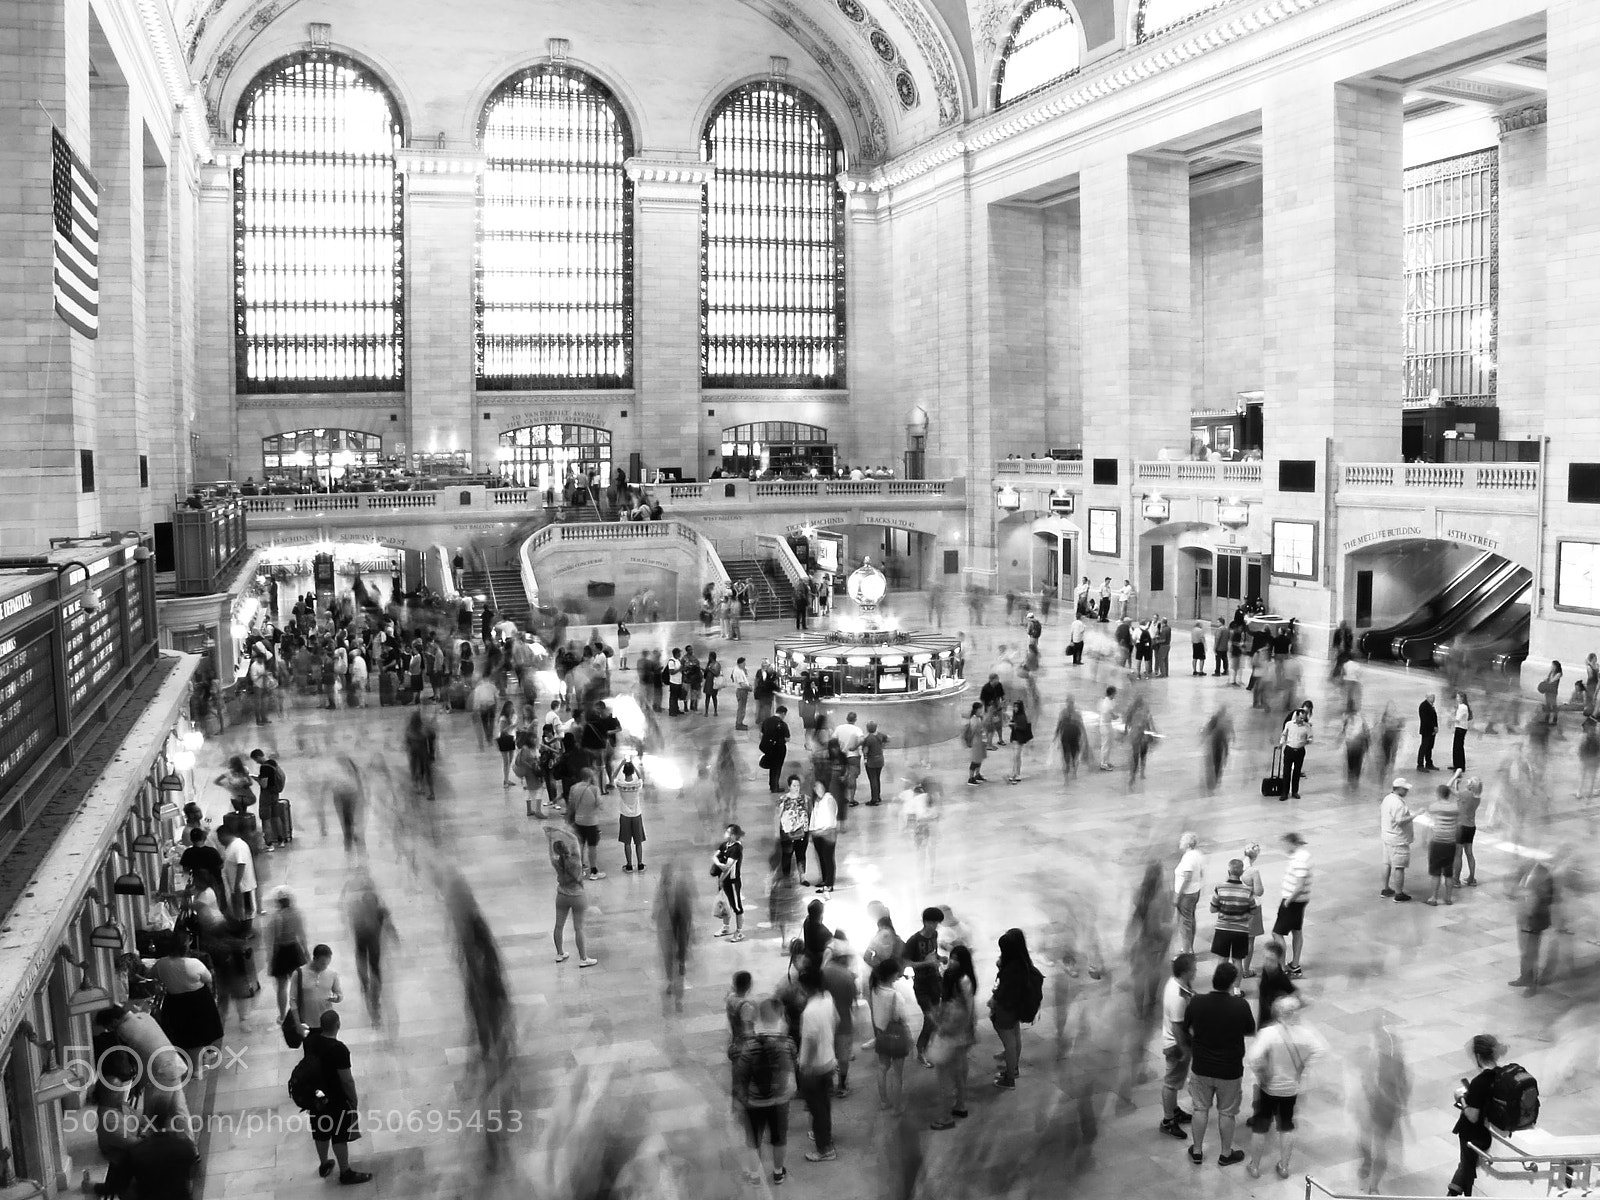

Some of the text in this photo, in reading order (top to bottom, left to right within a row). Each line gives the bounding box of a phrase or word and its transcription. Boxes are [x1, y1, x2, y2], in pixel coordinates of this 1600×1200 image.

[506, 420, 520, 429] THE
[810, 517, 845, 526] MACHINES
[865, 516, 891, 524] TRACKS
[1342, 526, 1422, 550] THE METLIFE BUILDING
[1447, 529, 1500, 549] 45TH STREET
